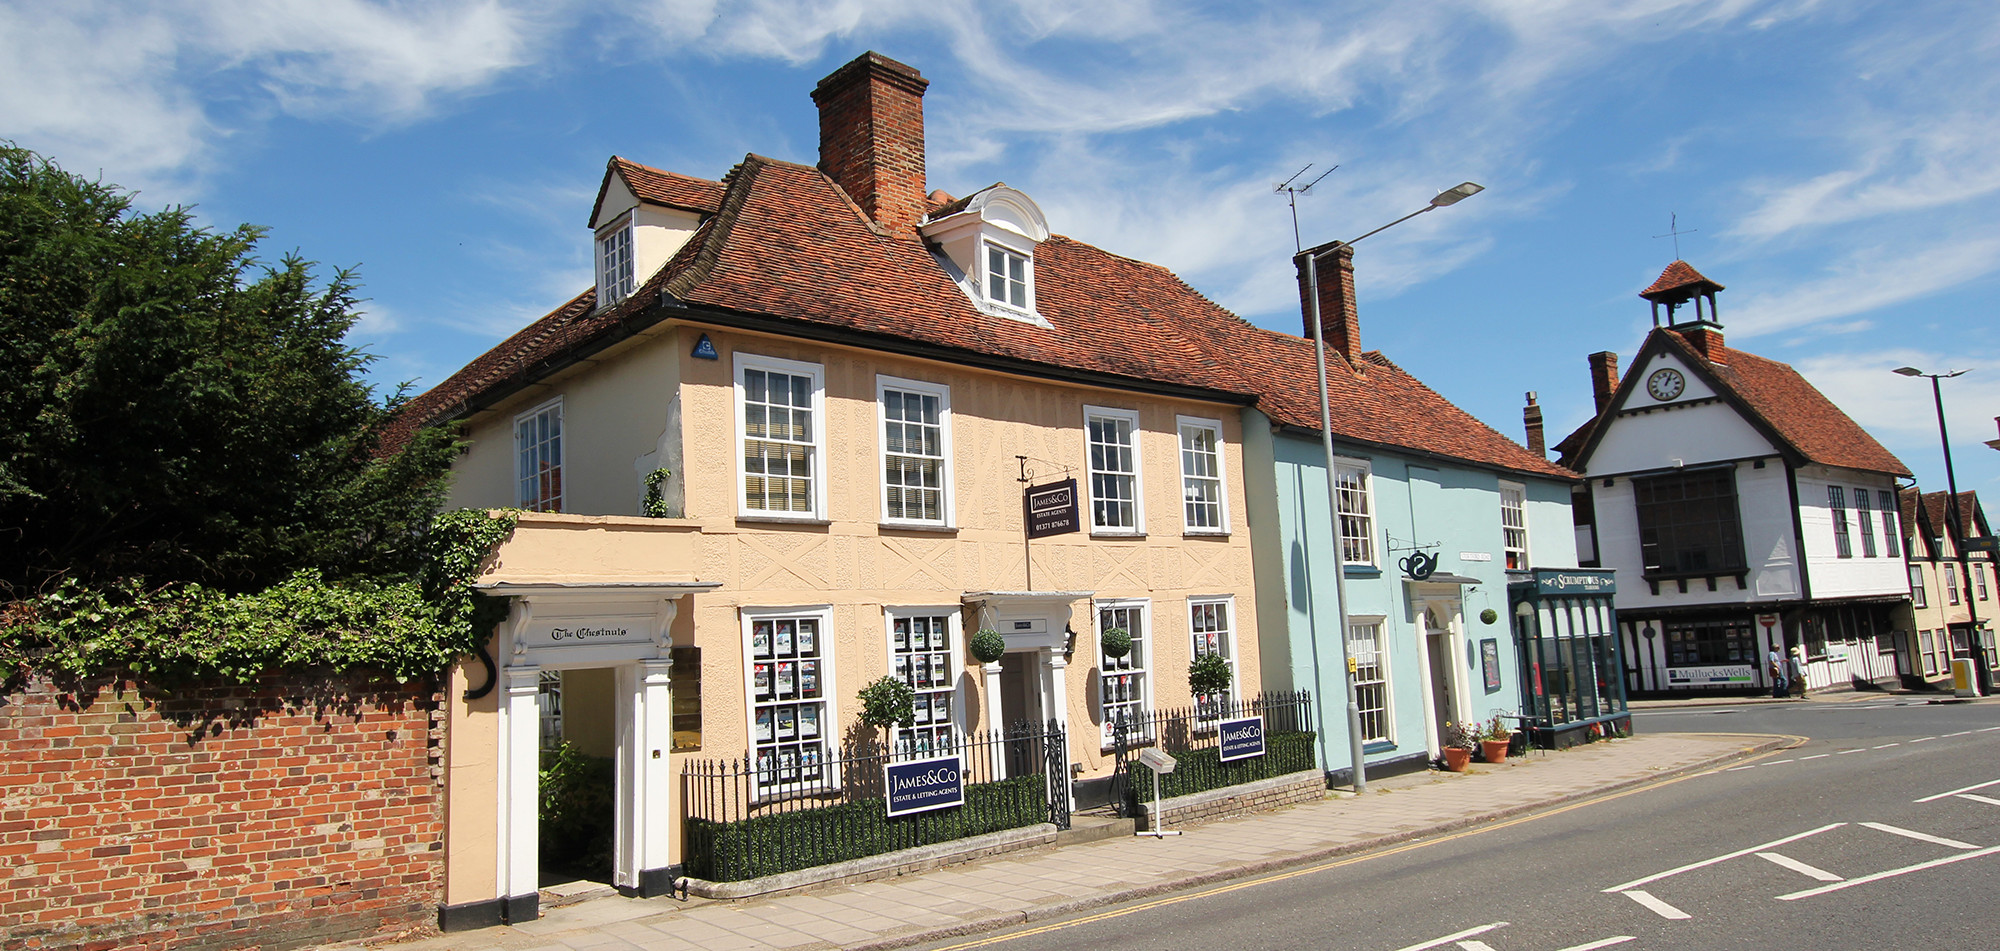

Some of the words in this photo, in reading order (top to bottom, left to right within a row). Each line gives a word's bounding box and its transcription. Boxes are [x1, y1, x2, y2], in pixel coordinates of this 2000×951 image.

[1036, 511, 1050, 519] ESTATE
[1051, 509, 1067, 517] AGENTS
[1035, 522, 1050, 531] 01371
[551, 628, 573, 641] The
[576, 627, 627, 640] Chestnuts
[1678, 667, 1751, 678] MullucksWells
[893, 794, 911, 803] ESTATE
[917, 789, 938, 799] LETTING
[938, 787, 958, 796] AGENTS
